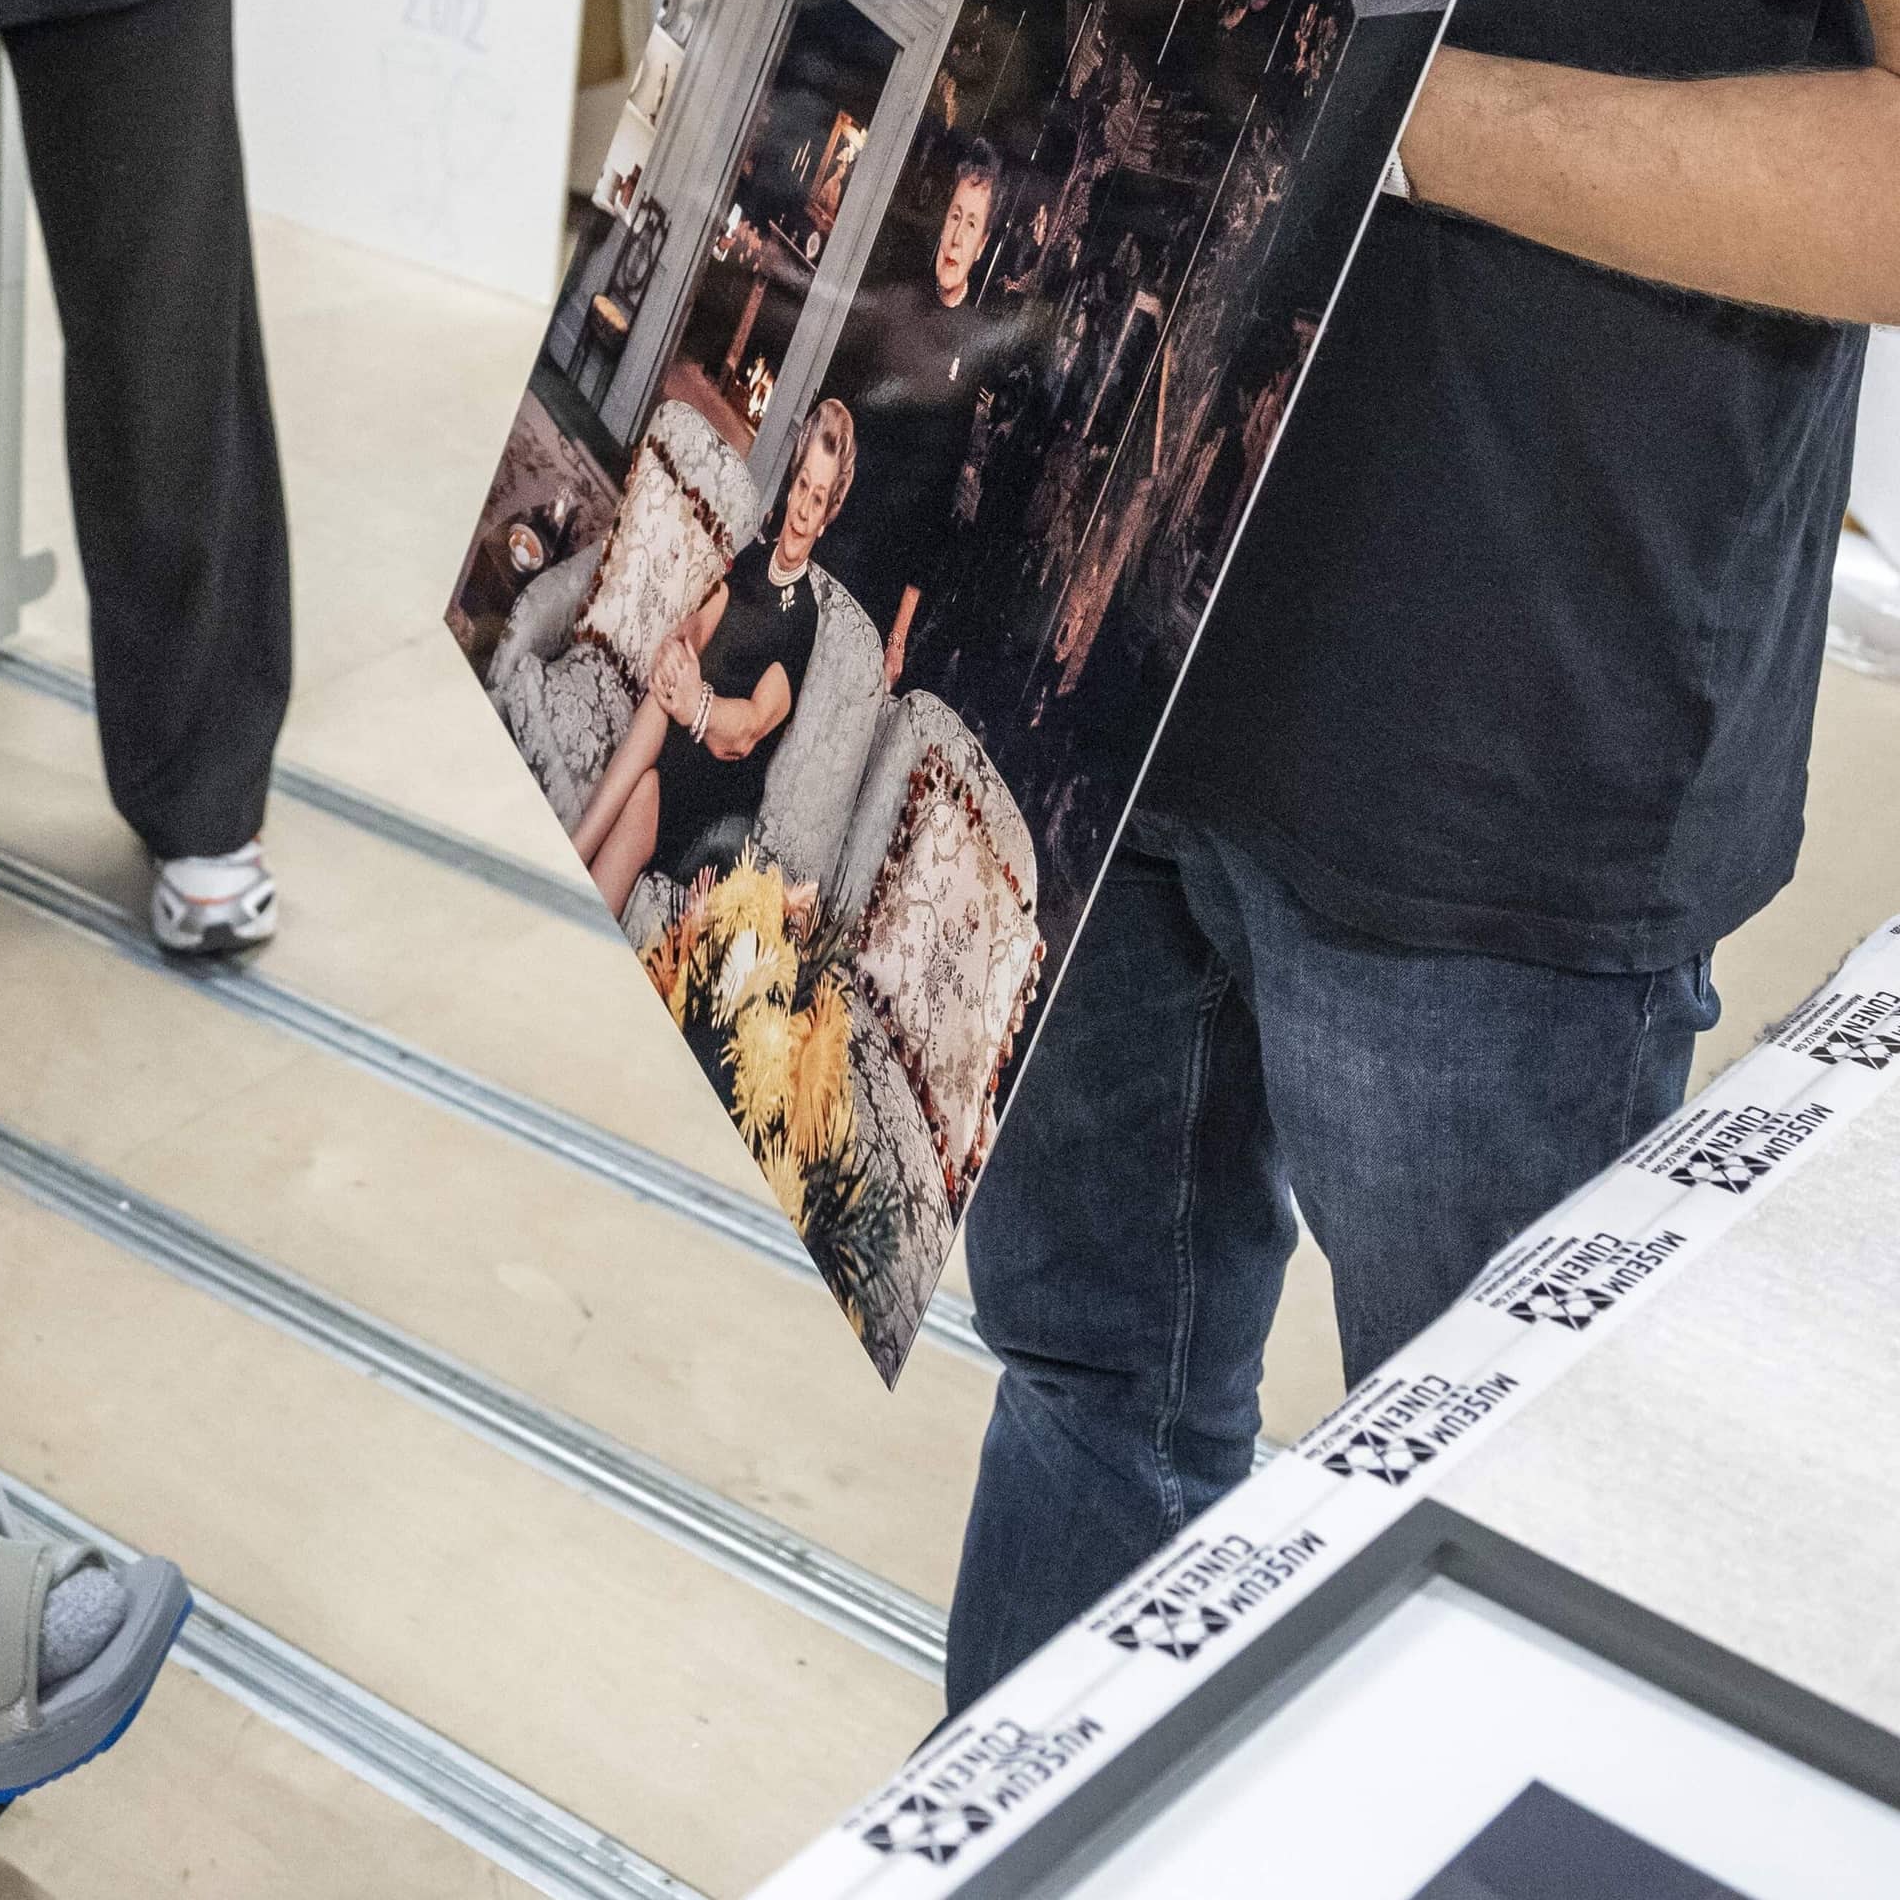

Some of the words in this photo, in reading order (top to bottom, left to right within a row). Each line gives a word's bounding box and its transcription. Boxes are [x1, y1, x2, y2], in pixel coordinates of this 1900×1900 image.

[1840, 991, 1900, 1035] CUNEN
[1704, 1105, 1772, 1154] CUNEN
[1755, 1102, 1835, 1162] MUSEUM
[1549, 1232, 1623, 1286] CUNEN
[1601, 1230, 1688, 1295] MUSEUM
[1371, 1374, 1452, 1434] CUNEN
[1425, 1372, 1520, 1446] MUSEUM
[1165, 1534, 1255, 1602] CUNEN
[1222, 1530, 1326, 1615] MUSEUM
[992, 1717, 1103, 1810] MUSEUM
